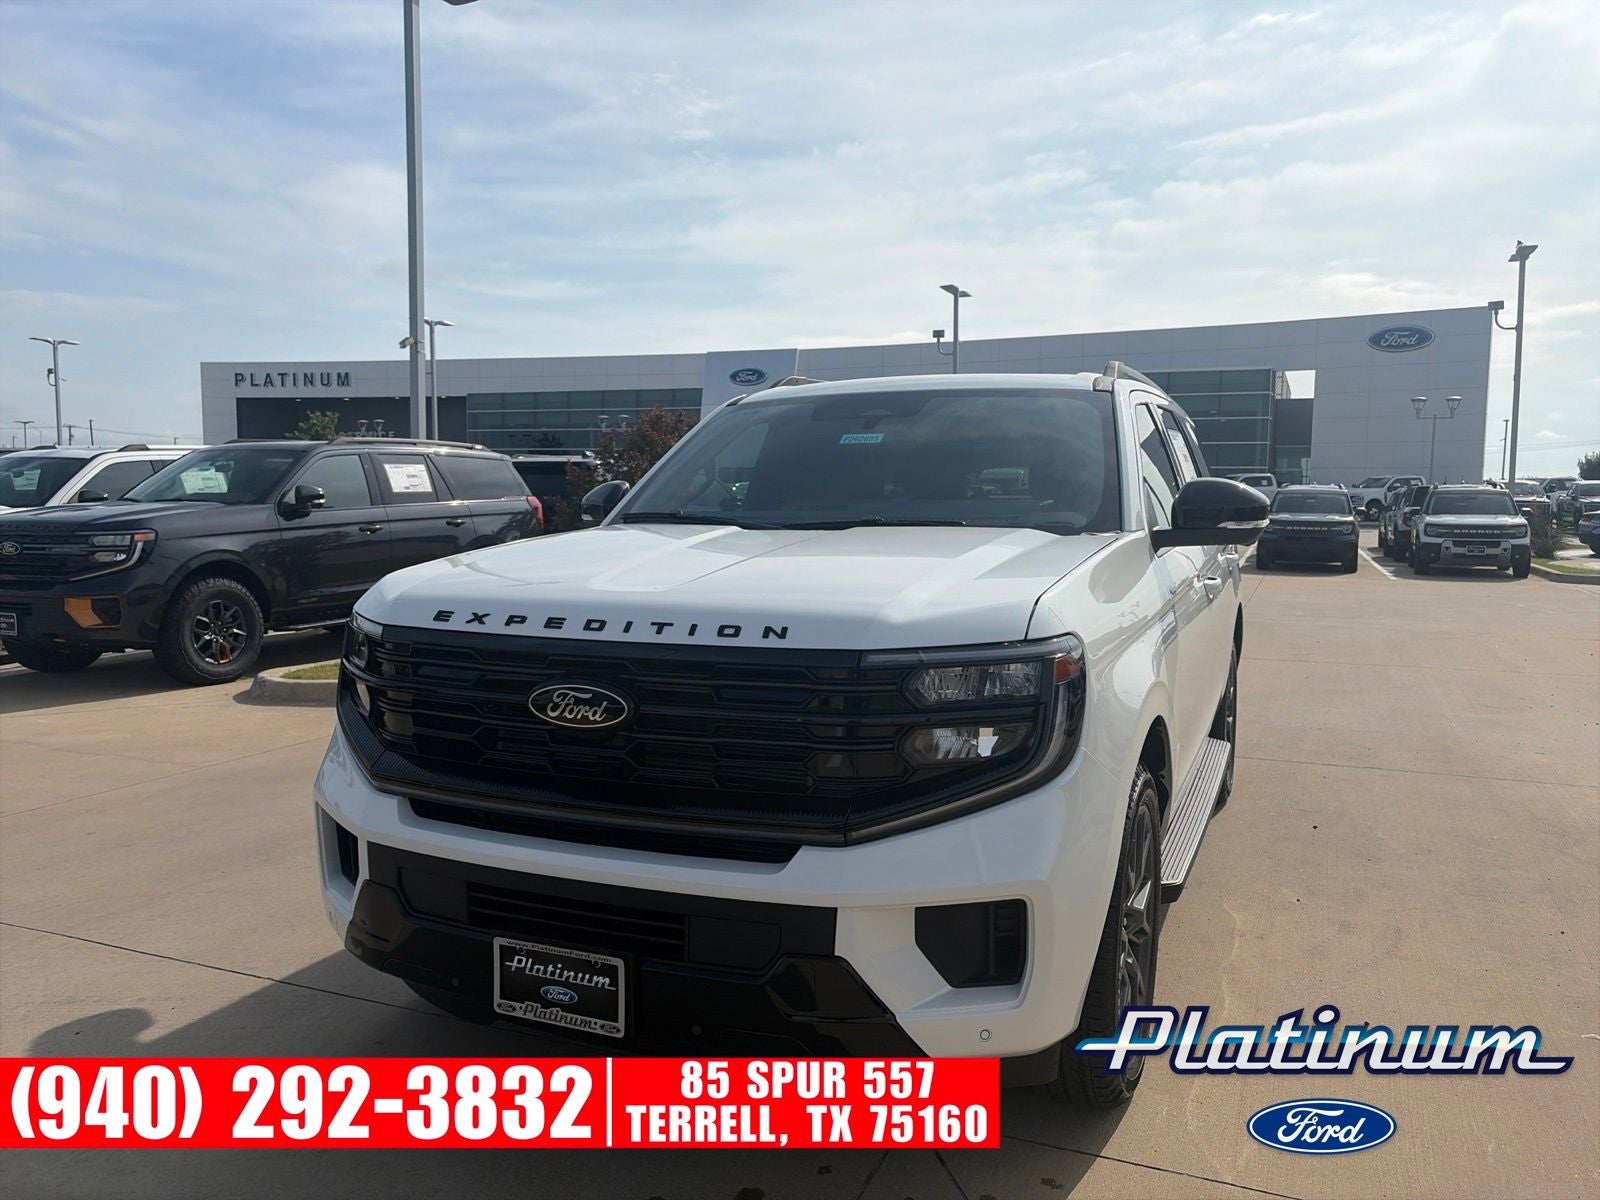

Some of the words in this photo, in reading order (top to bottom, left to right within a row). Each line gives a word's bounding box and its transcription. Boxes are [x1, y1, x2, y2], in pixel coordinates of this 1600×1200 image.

[1380, 331, 1420, 347] Ford
[234, 372, 352, 388] PLATINUM
[432, 609, 789, 640] EXPEDITION
[546, 689, 607, 722] Ford
[504, 955, 617, 991] Platinum
[547, 988, 571, 1002] Ford
[522, 1002, 598, 1030] Platinum
